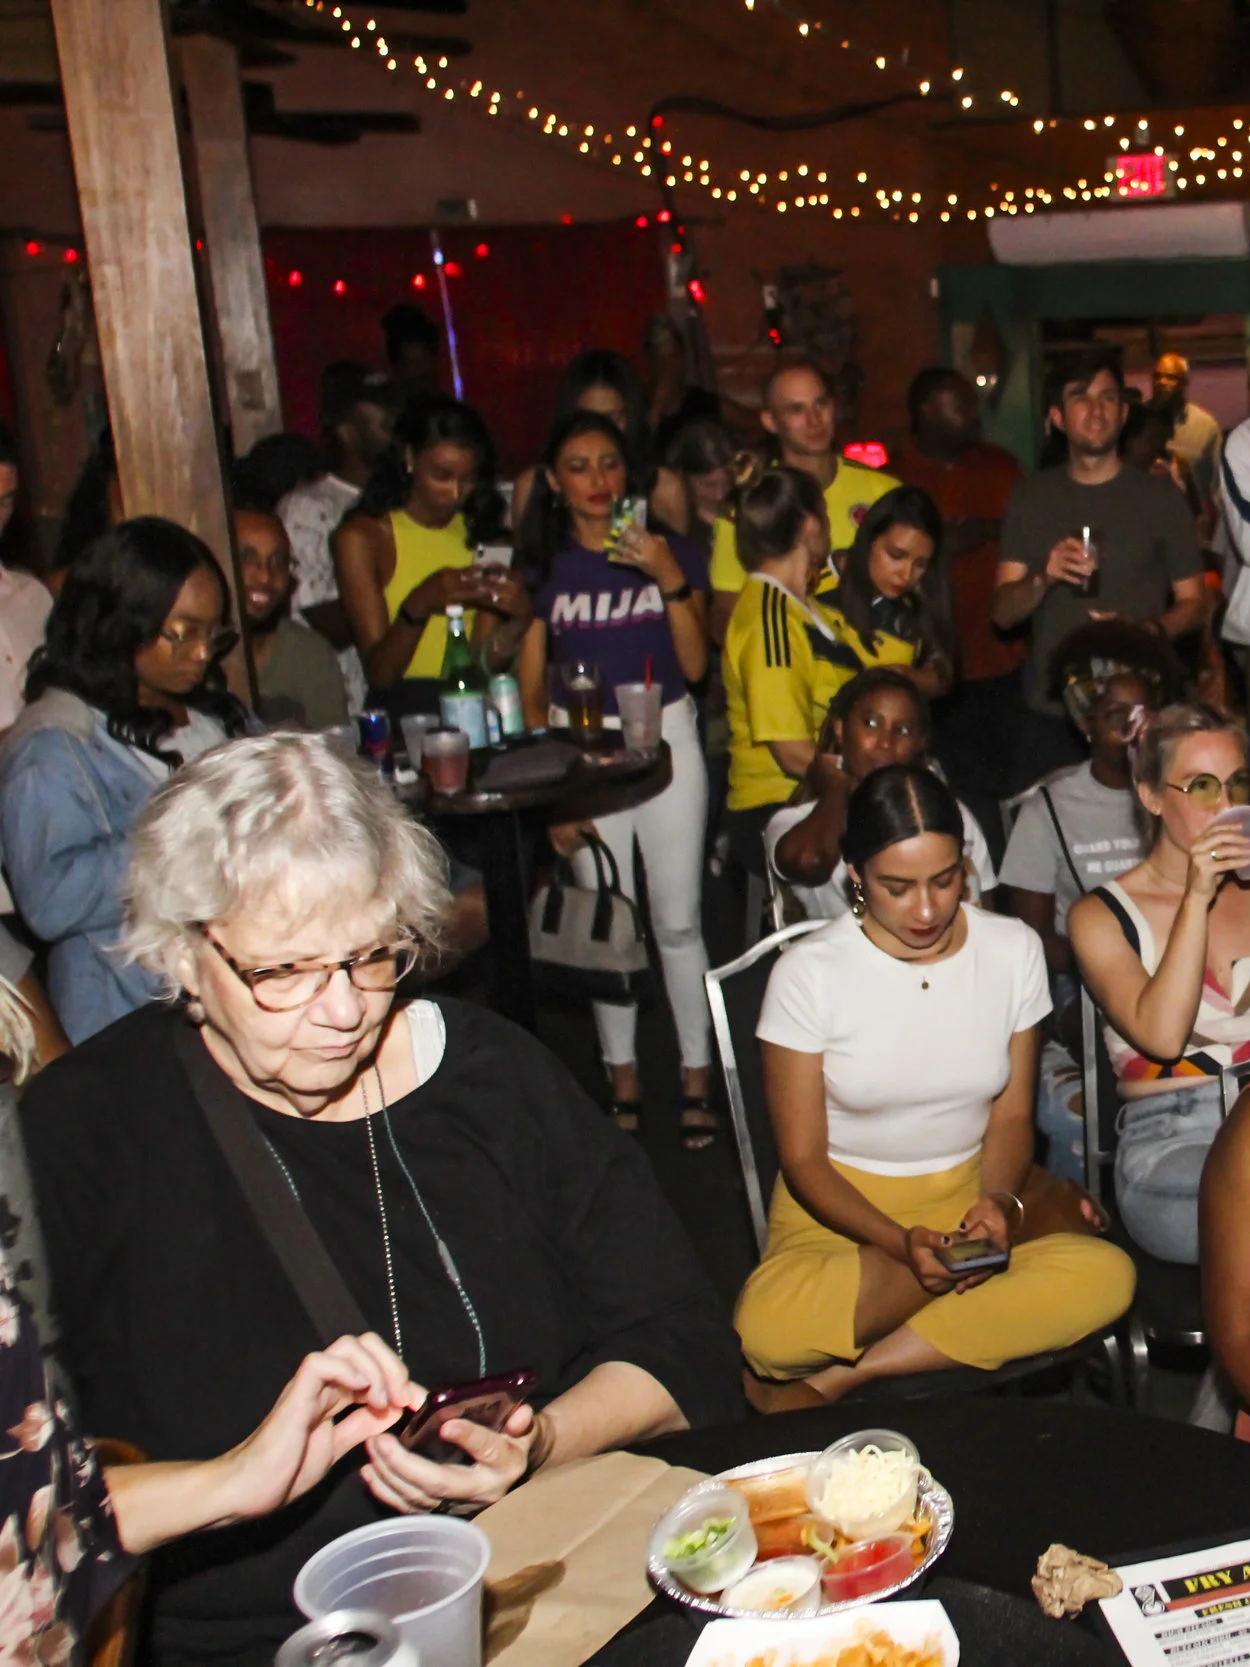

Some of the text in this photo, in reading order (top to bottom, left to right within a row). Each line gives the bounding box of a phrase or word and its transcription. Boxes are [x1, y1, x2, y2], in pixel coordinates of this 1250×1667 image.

[551, 583, 664, 626] MIJA
[1184, 1569, 1233, 1593] FRY
[1201, 1599, 1242, 1617] FRESH
